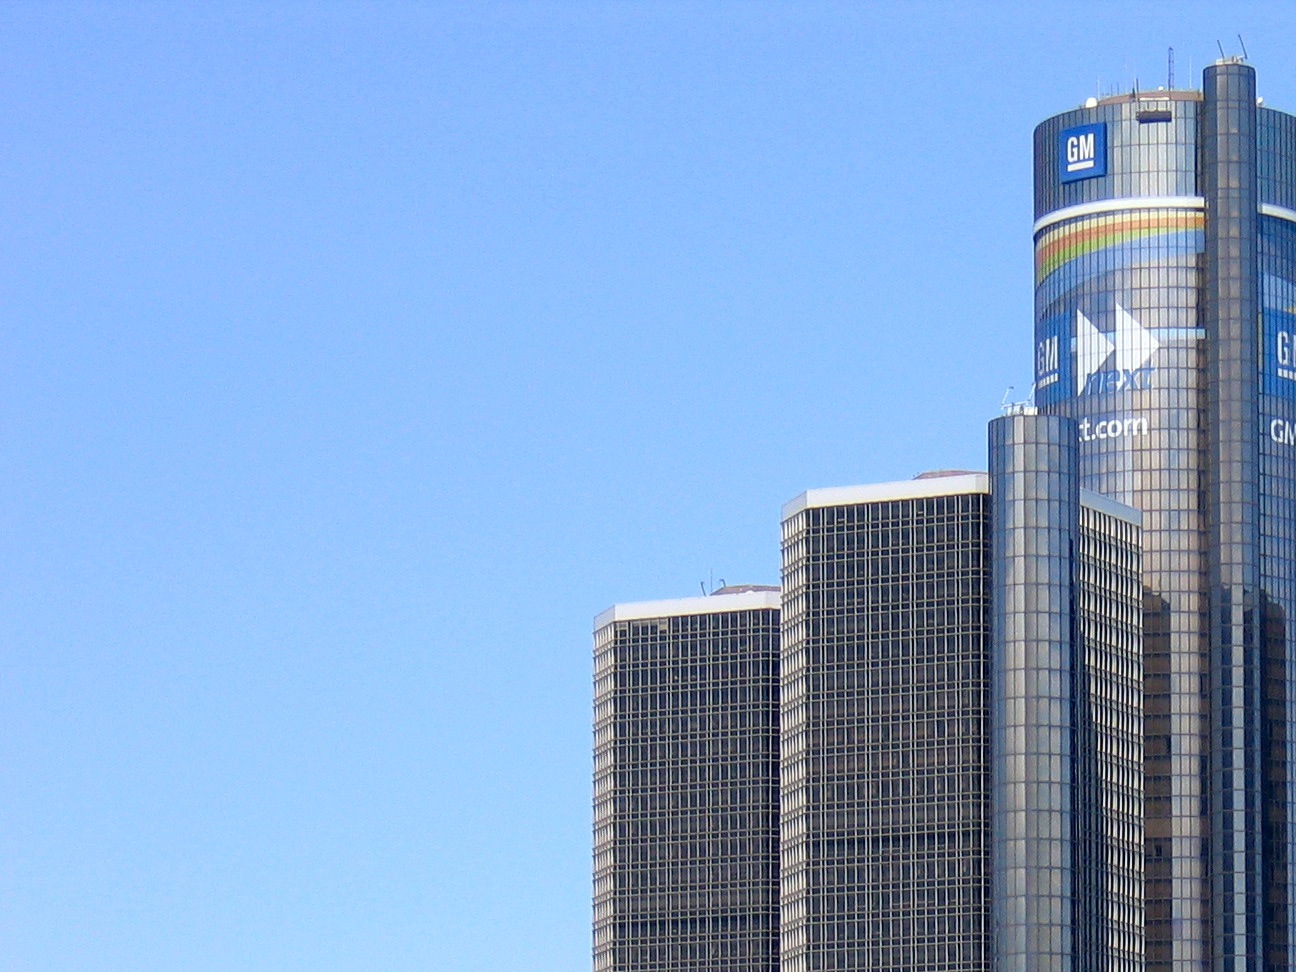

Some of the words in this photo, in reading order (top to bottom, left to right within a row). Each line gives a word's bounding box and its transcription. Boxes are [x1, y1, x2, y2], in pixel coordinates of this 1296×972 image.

[1067, 132, 1094, 163] GM
[1037, 335, 1058, 377] GM
[1086, 362, 1157, 395] next
